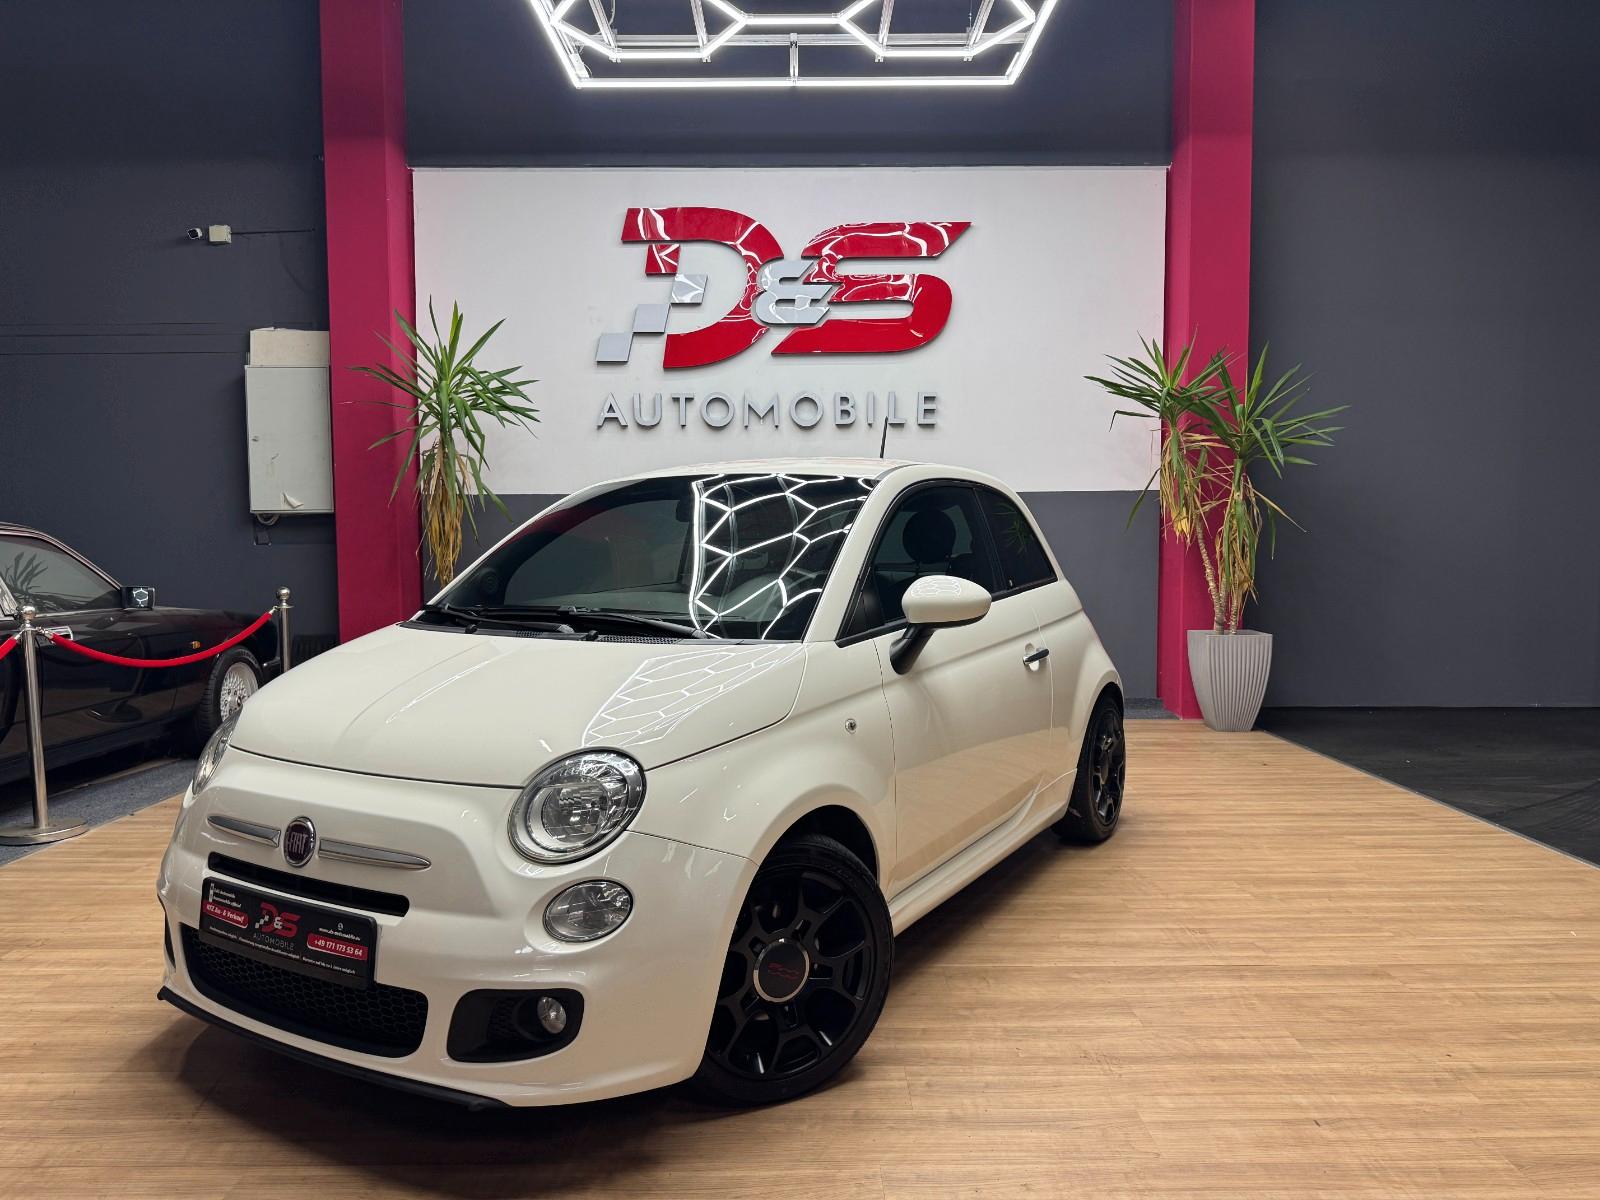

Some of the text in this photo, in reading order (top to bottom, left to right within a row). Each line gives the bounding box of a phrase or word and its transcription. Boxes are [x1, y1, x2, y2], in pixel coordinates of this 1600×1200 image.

[621, 206, 972, 370] D&S
[596, 391, 937, 429] AUTOMOBILE
[289, 831, 309, 855] FIAT
[227, 910, 245, 924] Verkauf
[259, 902, 301, 938] D&S
[253, 932, 295, 951] AUTOMOBILE
[314, 939, 325, 947] +49
[326, 941, 335, 950] 171
[336, 944, 345, 952] 173
